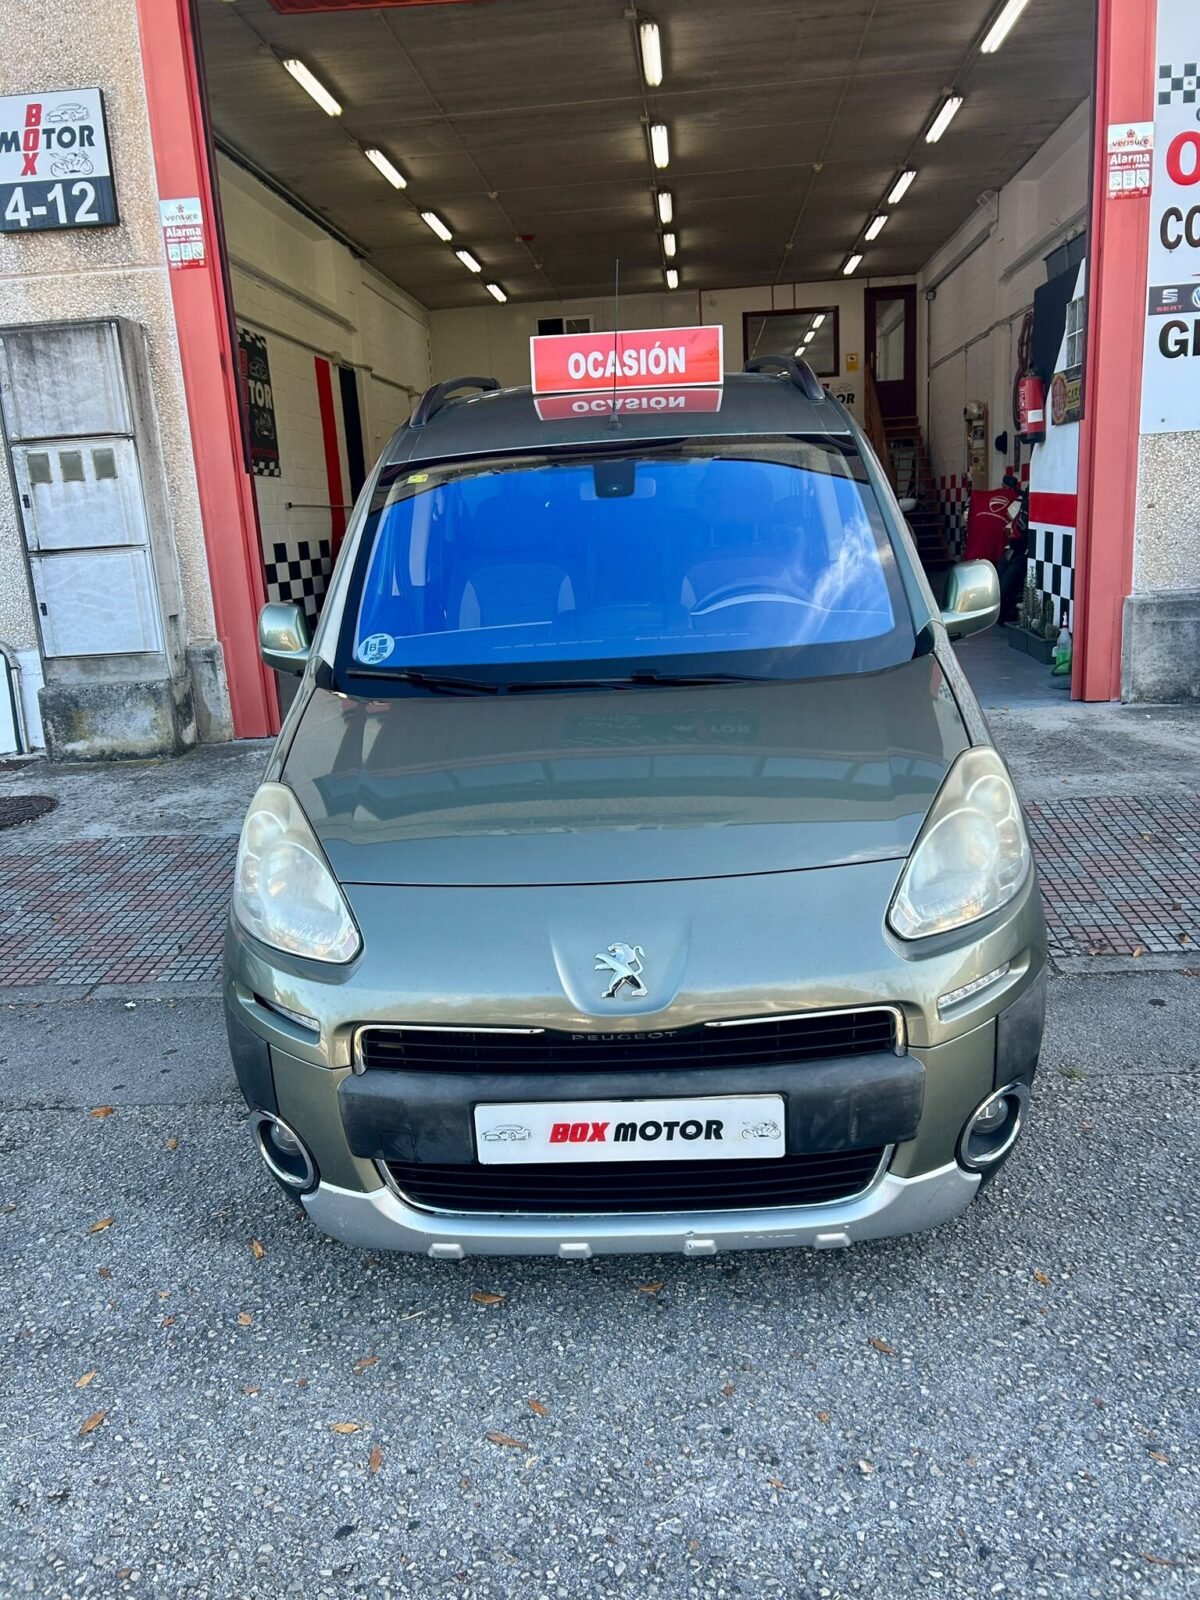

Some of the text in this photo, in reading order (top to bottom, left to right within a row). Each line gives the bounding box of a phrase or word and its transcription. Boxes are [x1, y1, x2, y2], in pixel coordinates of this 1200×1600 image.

[21, 103, 42, 176] BOX
[1112, 138, 1149, 147] verisure
[1110, 153, 1149, 166] Alarma
[4, 181, 99, 227] 4-12
[166, 226, 202, 239] Alarma
[567, 341, 686, 379] OCASIÓN
[571, 1030, 678, 1041] PEUGEOT
[549, 1119, 724, 1143] BOX MOTOR
